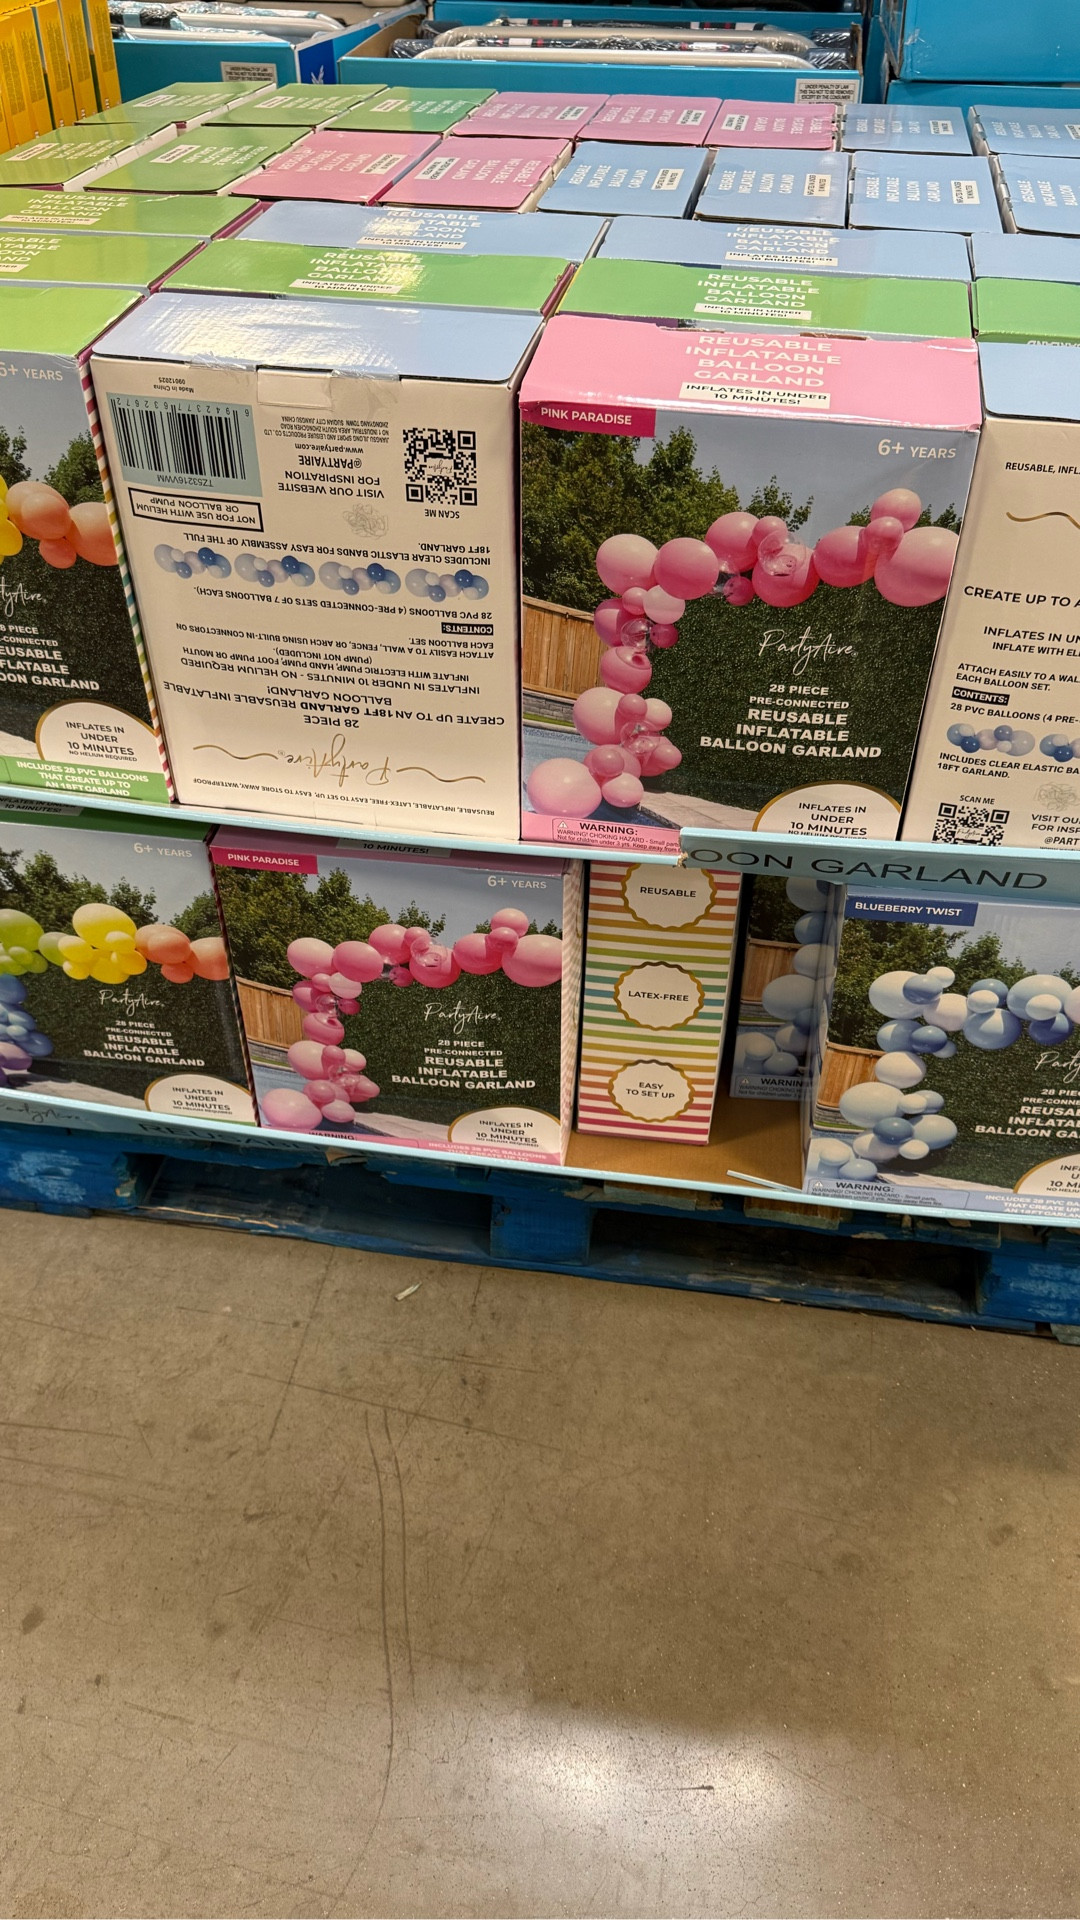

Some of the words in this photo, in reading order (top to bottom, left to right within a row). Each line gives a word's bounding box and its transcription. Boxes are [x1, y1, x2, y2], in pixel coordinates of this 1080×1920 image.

[569, 164, 592, 185] REUSABLE
[587, 165, 611, 188] INFLATABLE
[608, 169, 628, 187] BALLOON
[628, 169, 648, 188] GARLAND
[718, 170, 736, 190] REUSABLE
[738, 170, 756, 193] INFLATABLE
[759, 173, 775, 193] BALLOON
[779, 174, 795, 194] GARLAND
[866, 176, 880, 199] REUSABLE
[886, 177, 900, 202] INFLATABLE
[906, 181, 920, 201] BALLOON
[927, 182, 941, 202] GARLAND
[28, 199, 129, 208] INFLATABLE
[42, 194, 130, 202] REUSABLE
[20, 209, 103, 217] GARLAND
[29, 204, 111, 212] BALLOON
[387, 210, 480, 221] REUSABLE
[736, 226, 833, 237] REUSABLE
[727, 232, 840, 245] INFLATABLE
[737, 239, 829, 248] BALLOON
[735, 245, 829, 255] GARLAND
[708, 273, 813, 286] REUSABLE
[697, 280, 820, 294] INFLATABLE
[707, 288, 806, 301] BALLOON
[704, 296, 806, 307] GARLAND
[699, 335, 833, 352] REUSABLE
[685, 346, 842, 365] INFLATABLE
[698, 359, 824, 375] BALLOON
[22, 368, 63, 381] YEARS
[693, 370, 825, 387] GARLAND
[153, 384, 171, 392] China
[686, 384, 753, 395] INFLATES
[777, 391, 827, 400] UNDER
[732, 395, 801, 405] MINUTES!
[541, 407, 569, 421] PINK
[572, 411, 632, 426] PARADISE
[294, 442, 364, 454] www.partyaire.com
[878, 438, 905, 457] 6+
[911, 446, 956, 459] YEARS
[298, 455, 362, 469] @PARTYAIRE
[1005, 462, 1056, 474] REUSABLE,
[284, 470, 355, 484] INSPIRATION
[357, 475, 380, 486] FOR
[277, 482, 327, 495] WEBSITE
[329, 486, 354, 497] OUR
[356, 488, 385, 499] VISIT
[150, 497, 176, 507] PUMP
[178, 500, 222, 512] BALLOON
[136, 504, 168, 515] HELIUM
[169, 508, 194, 518] WITH
[195, 511, 214, 520] USE
[225, 505, 239, 513] OR
[424, 508, 437, 518] ME
[438, 509, 460, 519] SCAN
[215, 513, 235, 522] FOR
[236, 515, 256, 524] NOT
[193, 586, 224, 598] EACH).
[225, 590, 272, 603] BALLOONS
[964, 585, 1022, 603] CREATE
[1026, 594, 1047, 606] UP
[1051, 595, 1070, 607] TO
[274, 596, 280, 604] 7
[281, 596, 294, 605] OF
[294, 598, 318, 607] SETS
[319, 600, 396, 614] PRE-CONNECTED
[397, 605, 407, 615] (4
[409, 607, 458, 618] BALLOONS
[459, 611, 479, 620] PVC
[480, 611, 493, 620] 28
[443, 623, 492, 635] CONTENTS:
[758, 625, 853, 676] PartyAire
[180, 657, 235, 672] REQUIRED
[237, 665, 279, 677] HELIUM
[280, 670, 298, 679] NO
[306, 673, 355, 685] MINUTES
[33, 676, 100, 691] GARLAND
[358, 677, 370, 686] 10
[371, 678, 411, 689] UNDER
[413, 682, 425, 690] IN
[163, 681, 231, 701] INFLATABLE
[266, 685, 330, 700] GARLAND!
[427, 683, 480, 695] INFLATES
[769, 684, 785, 694] 28
[789, 685, 829, 696] PIECE
[233, 693, 297, 709] REUSABLE
[333, 692, 392, 706] BALLOON
[749, 696, 850, 709] PRE-CONNECTED
[953, 688, 1010, 705] CONTENTS:
[300, 701, 360, 715] GARLAND
[363, 707, 396, 717] 18FT
[303, 714, 341, 727] PIECE
[397, 711, 413, 720] AN
[416, 712, 434, 721] TO
[435, 714, 453, 722] UP
[456, 715, 505, 726] CREATE
[747, 708, 848, 725] REUSABLE
[66, 721, 112, 733] INFLATES
[115, 726, 125, 734] IN
[344, 718, 360, 729] 28
[80, 732, 119, 743] UNDER
[736, 723, 850, 742] INFLATABLE
[67, 741, 80, 750] 10
[83, 743, 135, 756] MINUTES
[699, 736, 786, 754] BALLOON
[792, 745, 882, 758] GARLAND
[798, 802, 852, 813] INFLATES
[855, 806, 867, 814] IN
[811, 813, 854, 824] UNDER
[579, 822, 638, 836] WARNING:
[791, 821, 804, 830] 10
[807, 824, 867, 836] MINUTES
[556, 829, 589, 837] WARNING!
[589, 832, 618, 841] CHOKING
[619, 835, 645, 844] HAZARD
[133, 843, 153, 854] 6+
[157, 847, 193, 858] YEARS
[363, 842, 378, 850] 10
[381, 844, 430, 854] MINUTES!
[227, 853, 250, 863] PINK
[251, 856, 300, 867] PARADISE
[811, 858, 1048, 890] GARLAND
[487, 875, 507, 888] 6+
[511, 880, 547, 890] YEARS
[639, 885, 697, 898] REUSABLE
[854, 901, 924, 915] BLUEBERRY
[925, 907, 963, 917] TWIST
[628, 990, 690, 1002] LATEX-FREE
[391, 1075, 461, 1089] BALLOON
[464, 1079, 537, 1089] GARLAND
[638, 1082, 664, 1091] EASY
[625, 1087, 638, 1096] TO
[640, 1090, 659, 1099] SET
[661, 1092, 676, 1100] UP
